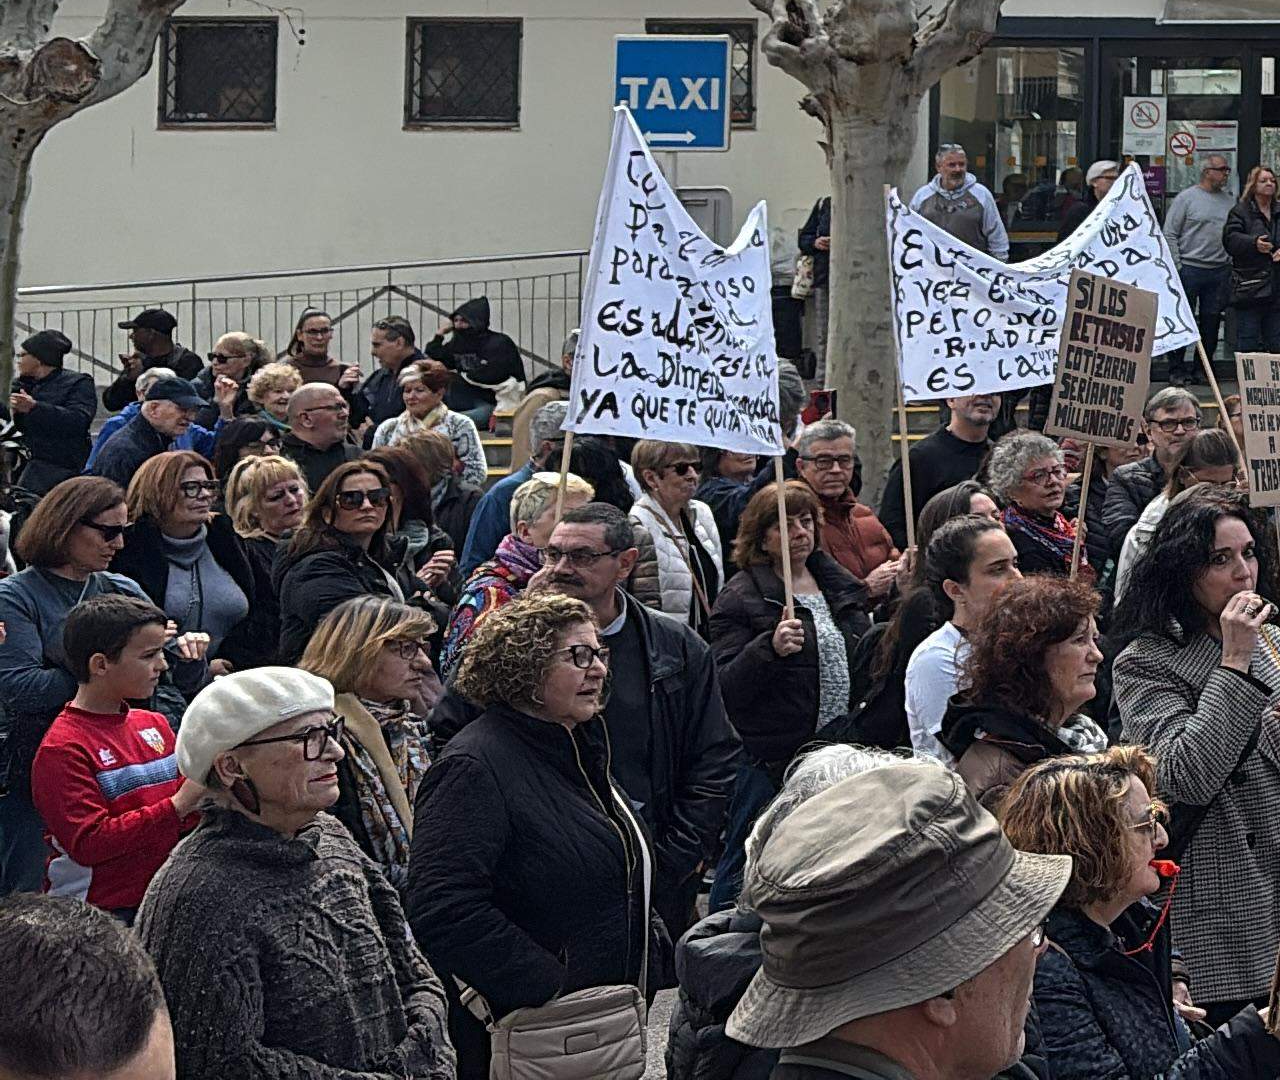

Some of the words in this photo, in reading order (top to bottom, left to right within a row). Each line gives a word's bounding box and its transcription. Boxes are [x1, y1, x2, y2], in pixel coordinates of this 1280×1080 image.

[620, 77, 720, 110] TAXI
[1099, 283, 1128, 318] LOS
[1069, 311, 1146, 354] RETRASOS
[576, 388, 621, 424] YA
[631, 392, 670, 431] QUE
[674, 397, 697, 426] TE
[1268, 435, 1276, 454] A
